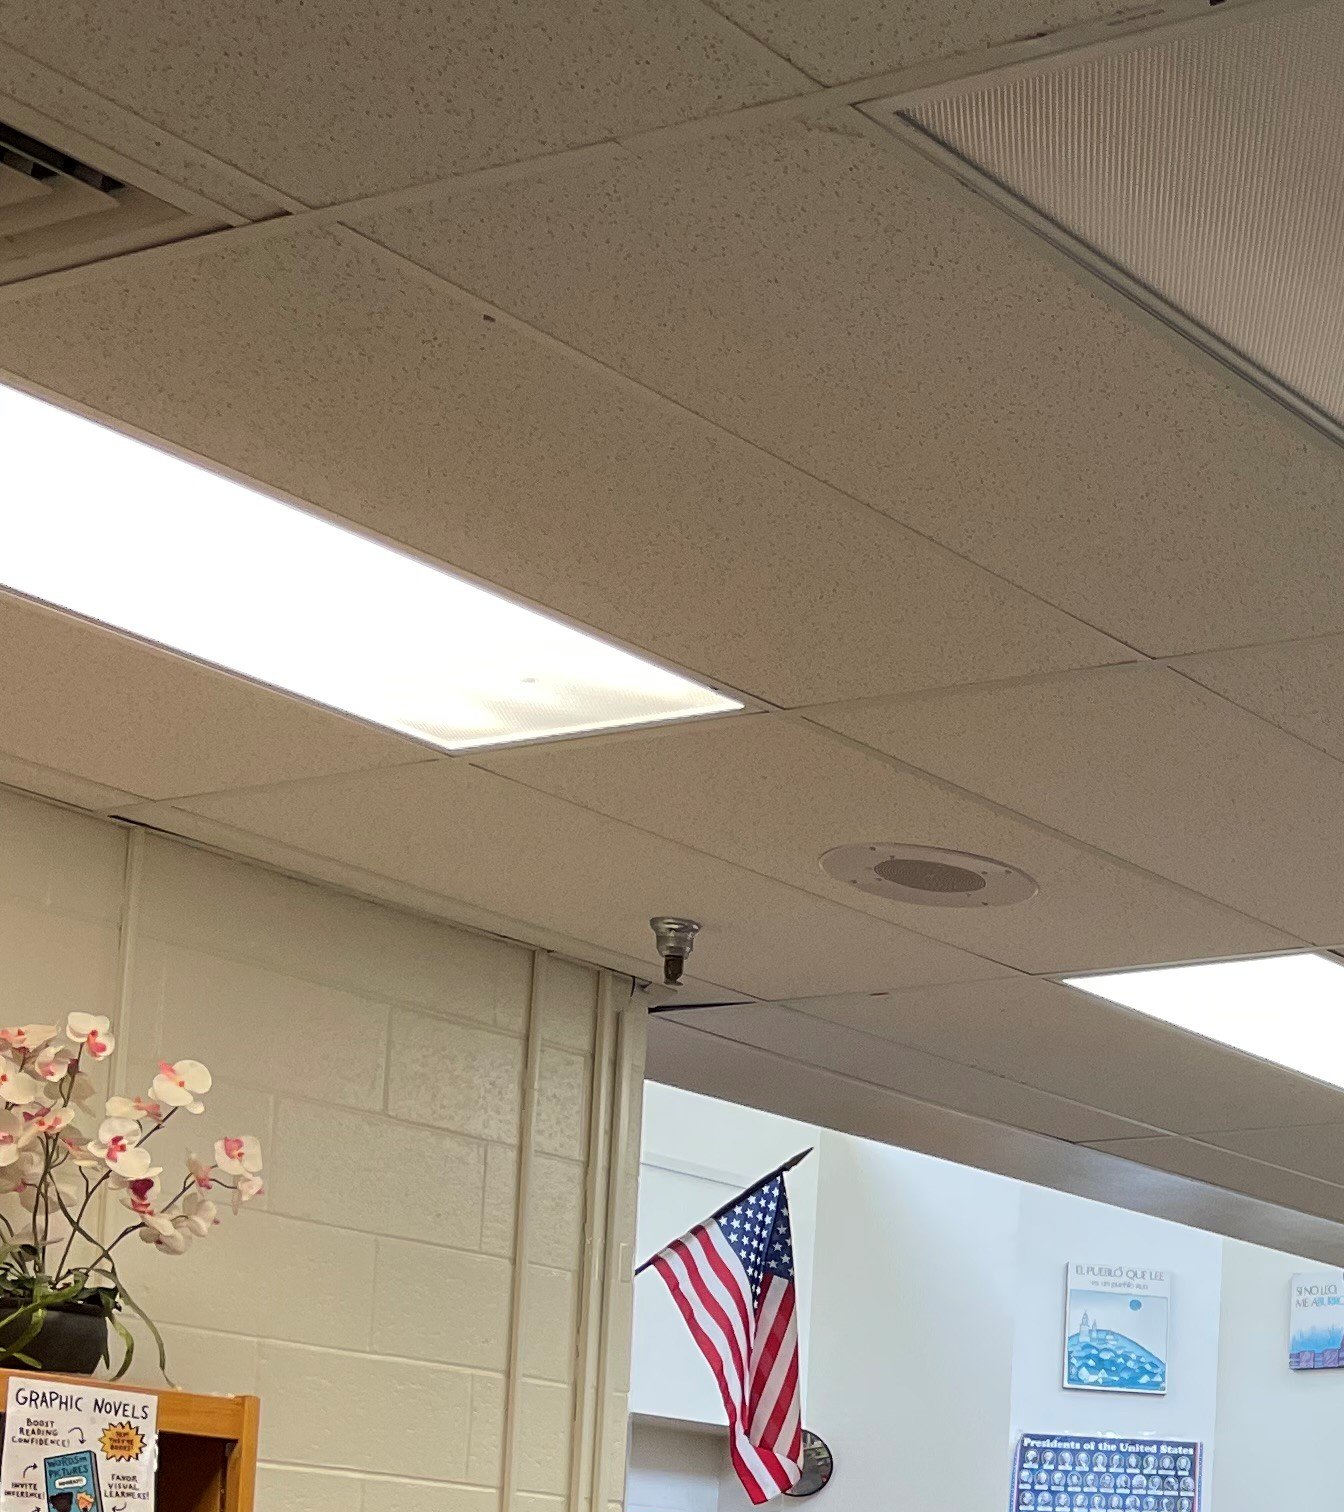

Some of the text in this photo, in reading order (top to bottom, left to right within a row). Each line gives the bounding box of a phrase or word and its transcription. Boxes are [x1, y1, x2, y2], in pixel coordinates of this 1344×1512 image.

[15, 1387, 150, 1420] GRAPHIC NOVELS
[26, 1418, 55, 1427] BOOST
[19, 1427, 59, 1437] READING
[11, 1436, 71, 1448] CONFIDENCE!
[1022, 1437, 1194, 1455] Presidents of the United States
[48, 1465, 89, 1478] PICTURES
[107, 1482, 140, 1491] VISUAL
